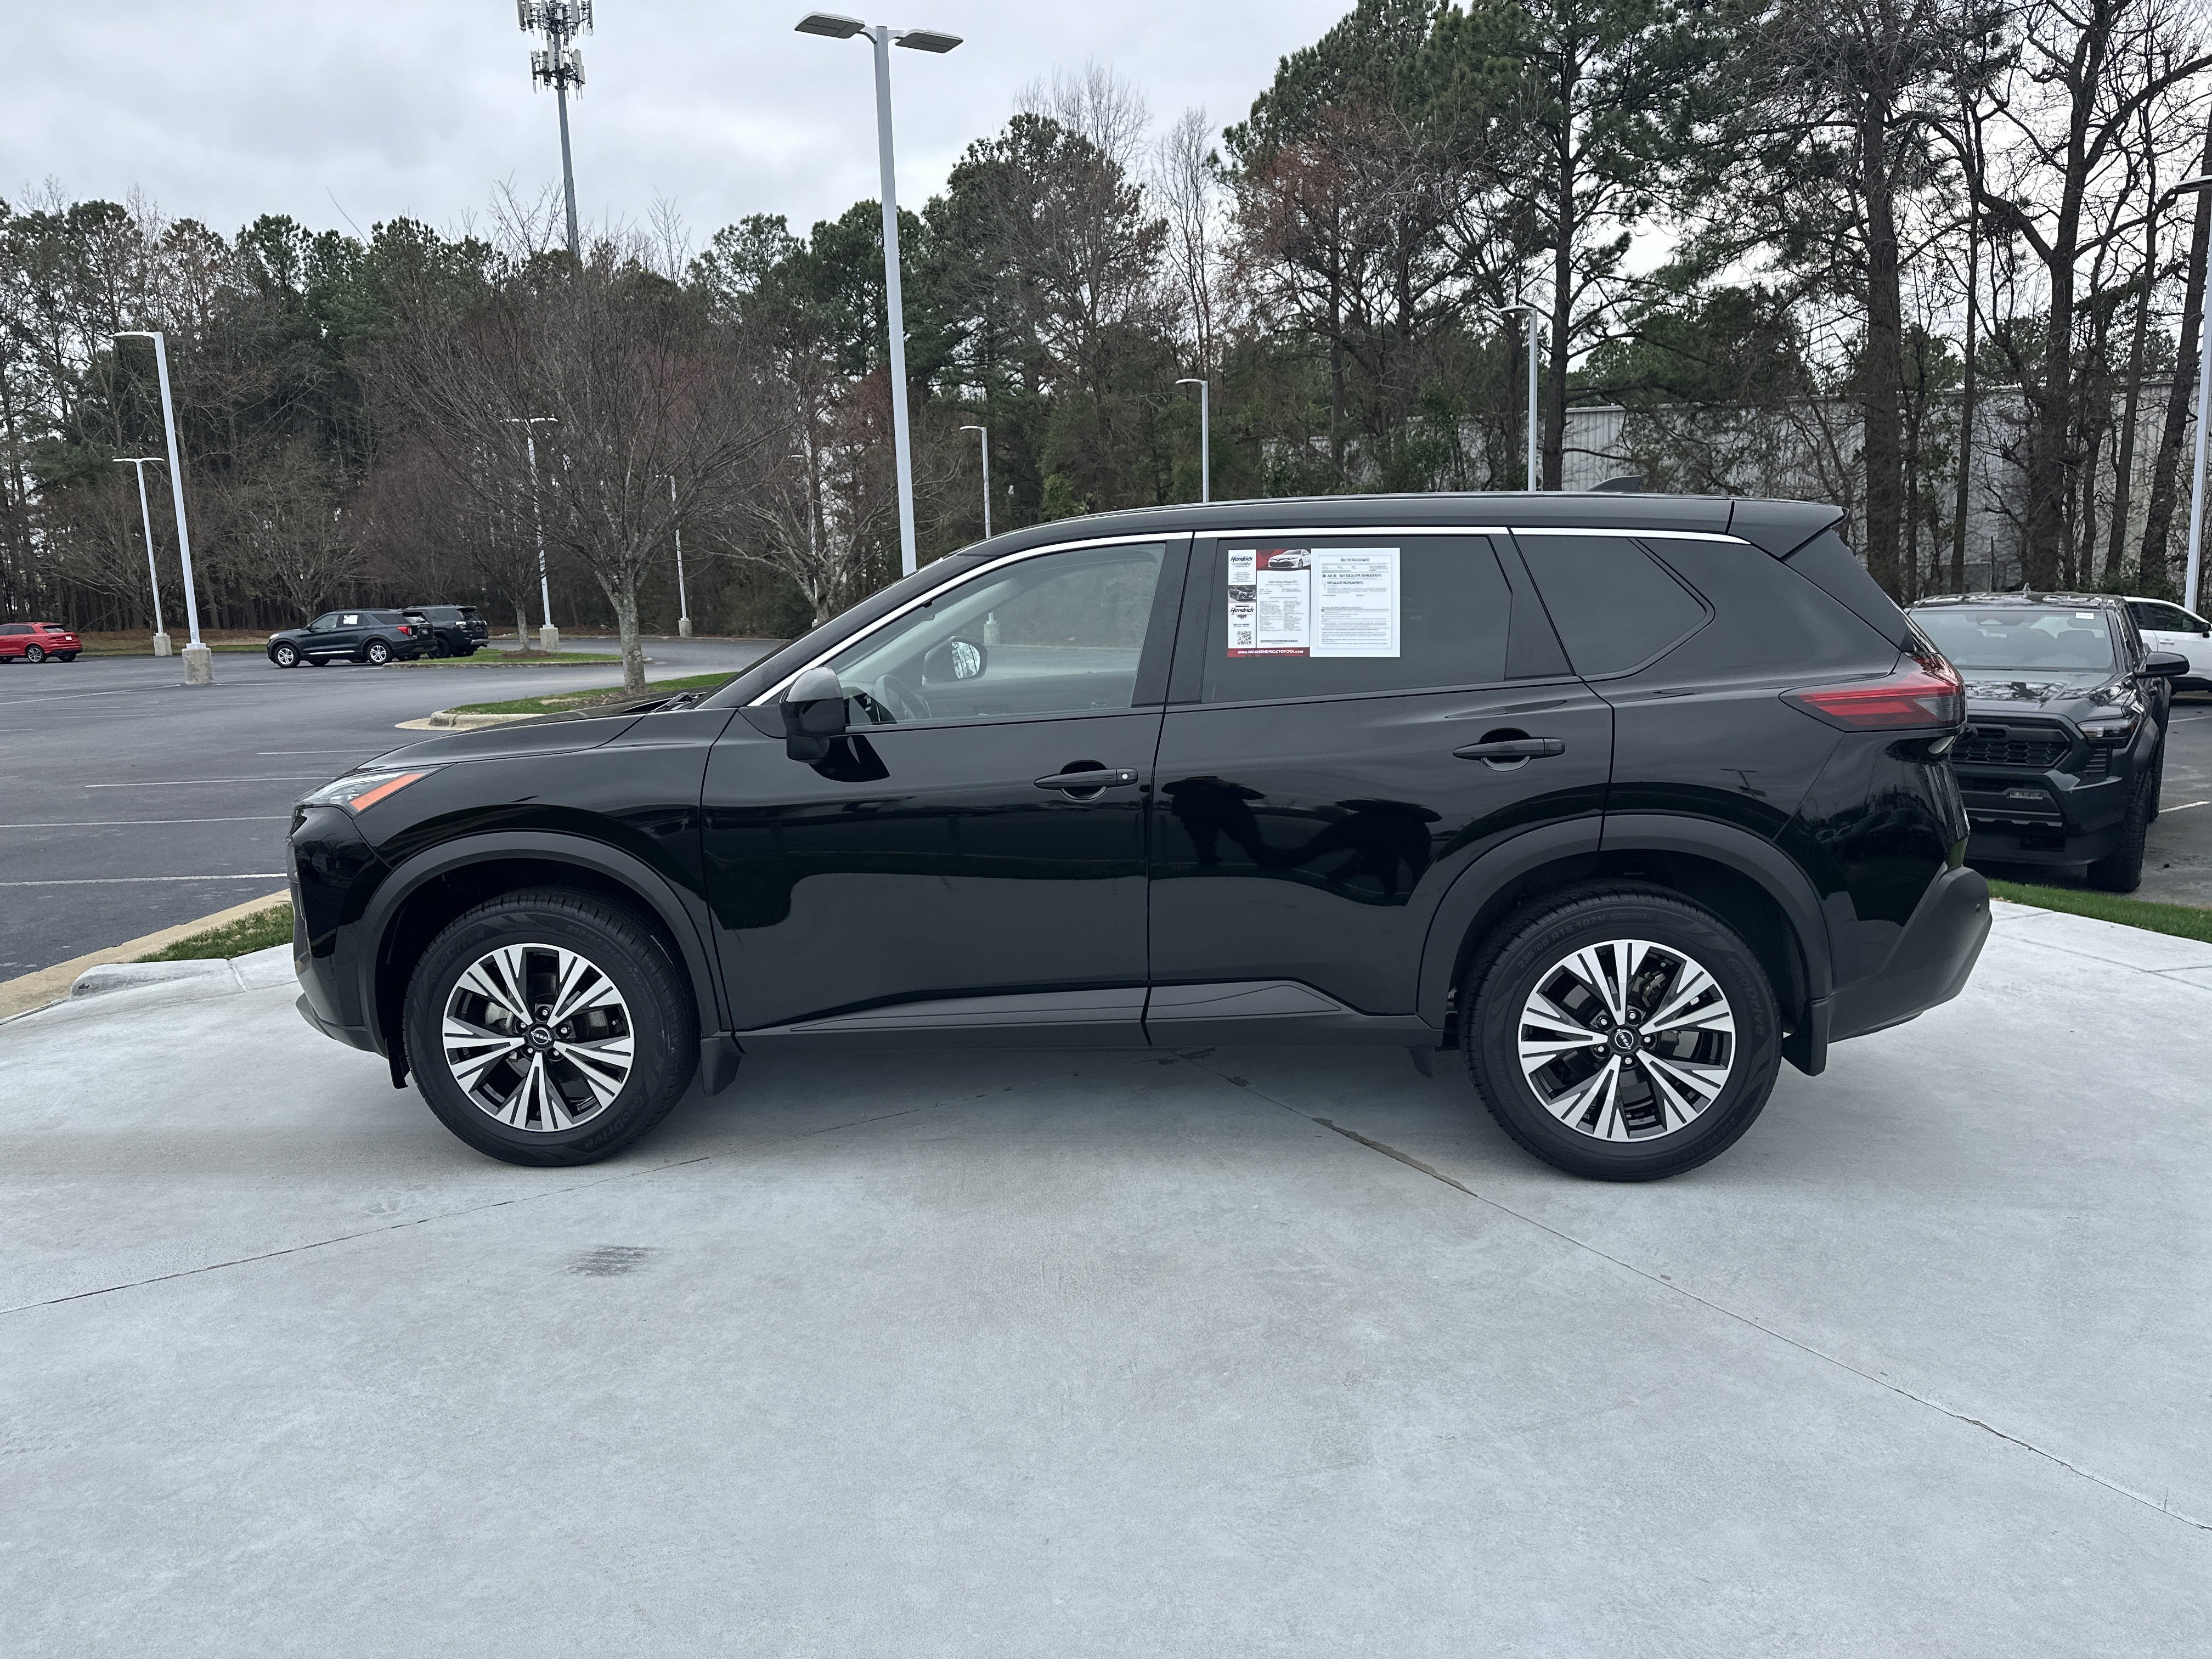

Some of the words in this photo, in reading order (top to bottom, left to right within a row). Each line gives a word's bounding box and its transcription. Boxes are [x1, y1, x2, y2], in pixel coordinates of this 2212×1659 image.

[1518, 939, 1549, 969] 235/60
[1551, 926, 1572, 940] R18
[1576, 915, 1606, 929] 107V
[1727, 957, 1764, 1036] GeoDrive
[531, 1031, 552, 1041] NISSAN
[1617, 1028, 1632, 1050] NISSAN
[584, 1096, 644, 1149] GeoDrive
